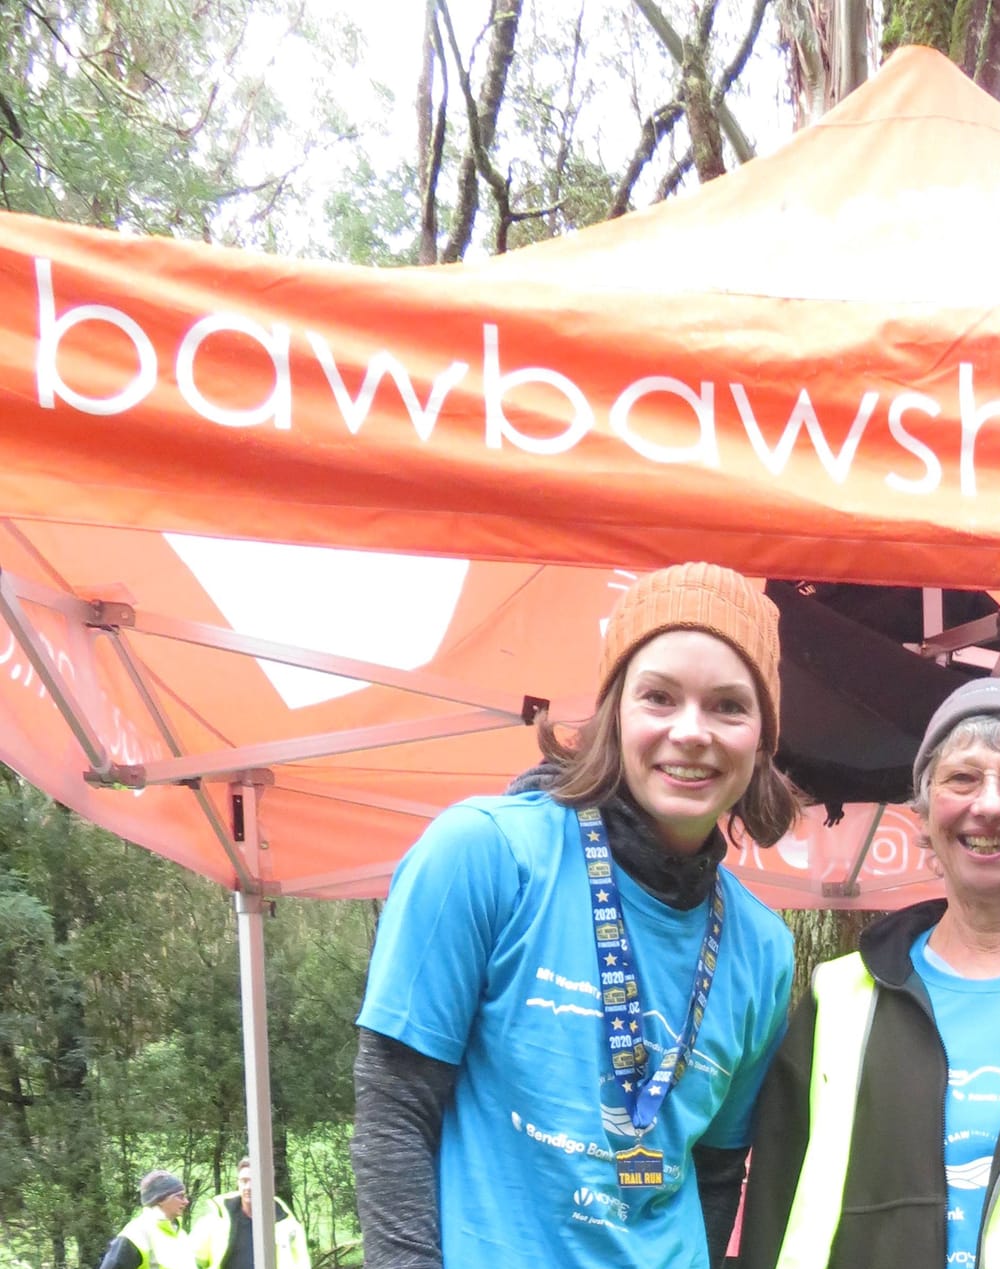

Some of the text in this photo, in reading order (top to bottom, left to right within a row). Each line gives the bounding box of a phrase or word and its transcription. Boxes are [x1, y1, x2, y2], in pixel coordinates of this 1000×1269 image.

[584, 846, 609, 859] 2020
[593, 907, 617, 921] 2020
[601, 971, 625, 985] 2020
[609, 1035, 633, 1049] 2020
[526, 1122, 585, 1155] Bendigo
[618, 1172, 643, 1185] TRAIL
[644, 1170, 663, 1184] RUN
